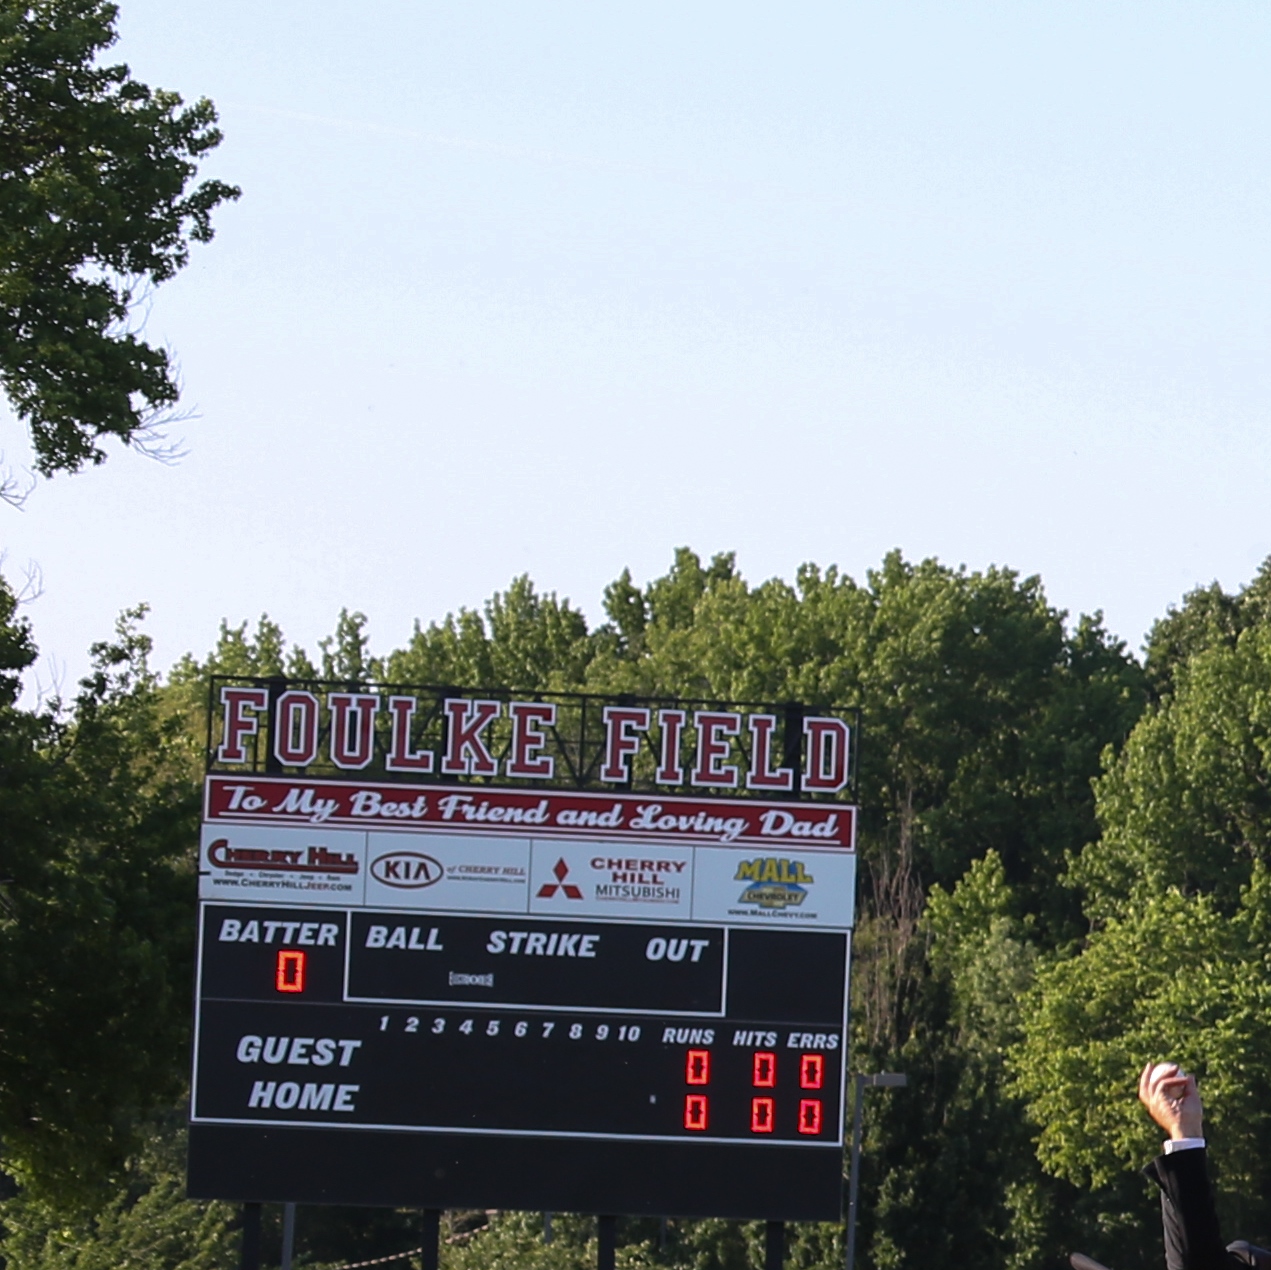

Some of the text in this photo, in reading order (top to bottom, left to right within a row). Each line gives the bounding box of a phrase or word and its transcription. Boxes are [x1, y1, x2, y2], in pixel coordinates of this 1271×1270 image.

[218, 687, 850, 793] FOULKE FIELD
[223, 786, 839, 843] To My Best Friend and Loving Dad
[384, 860, 431, 880] KIA
[458, 865, 500, 875] CHERRY
[502, 867, 526, 876] HILL
[590, 857, 687, 873] CHERRY
[734, 857, 814, 884] MALL
[595, 884, 681, 899] MITSUBISHI
[612, 872, 664, 885] HILL
[747, 889, 799, 902] CHEVROLET
[219, 919, 339, 946] BATTER
[365, 925, 444, 951] BALL
[487, 930, 600, 957] STRIKE
[645, 937, 709, 962] OUT
[276, 950, 305, 993] 0
[380, 1015, 641, 1042] 1 2 3 4 5 6 7 8 9 10
[662, 1027, 715, 1045] RUNS
[732, 1030, 777, 1048] HITS
[786, 1032, 839, 1050] ERRS
[236, 1035, 362, 1067] GUEST
[686, 1050, 823, 1089] 0 0 0
[248, 1081, 360, 1112] HOME
[684, 1094, 821, 1135] 0 0 0
